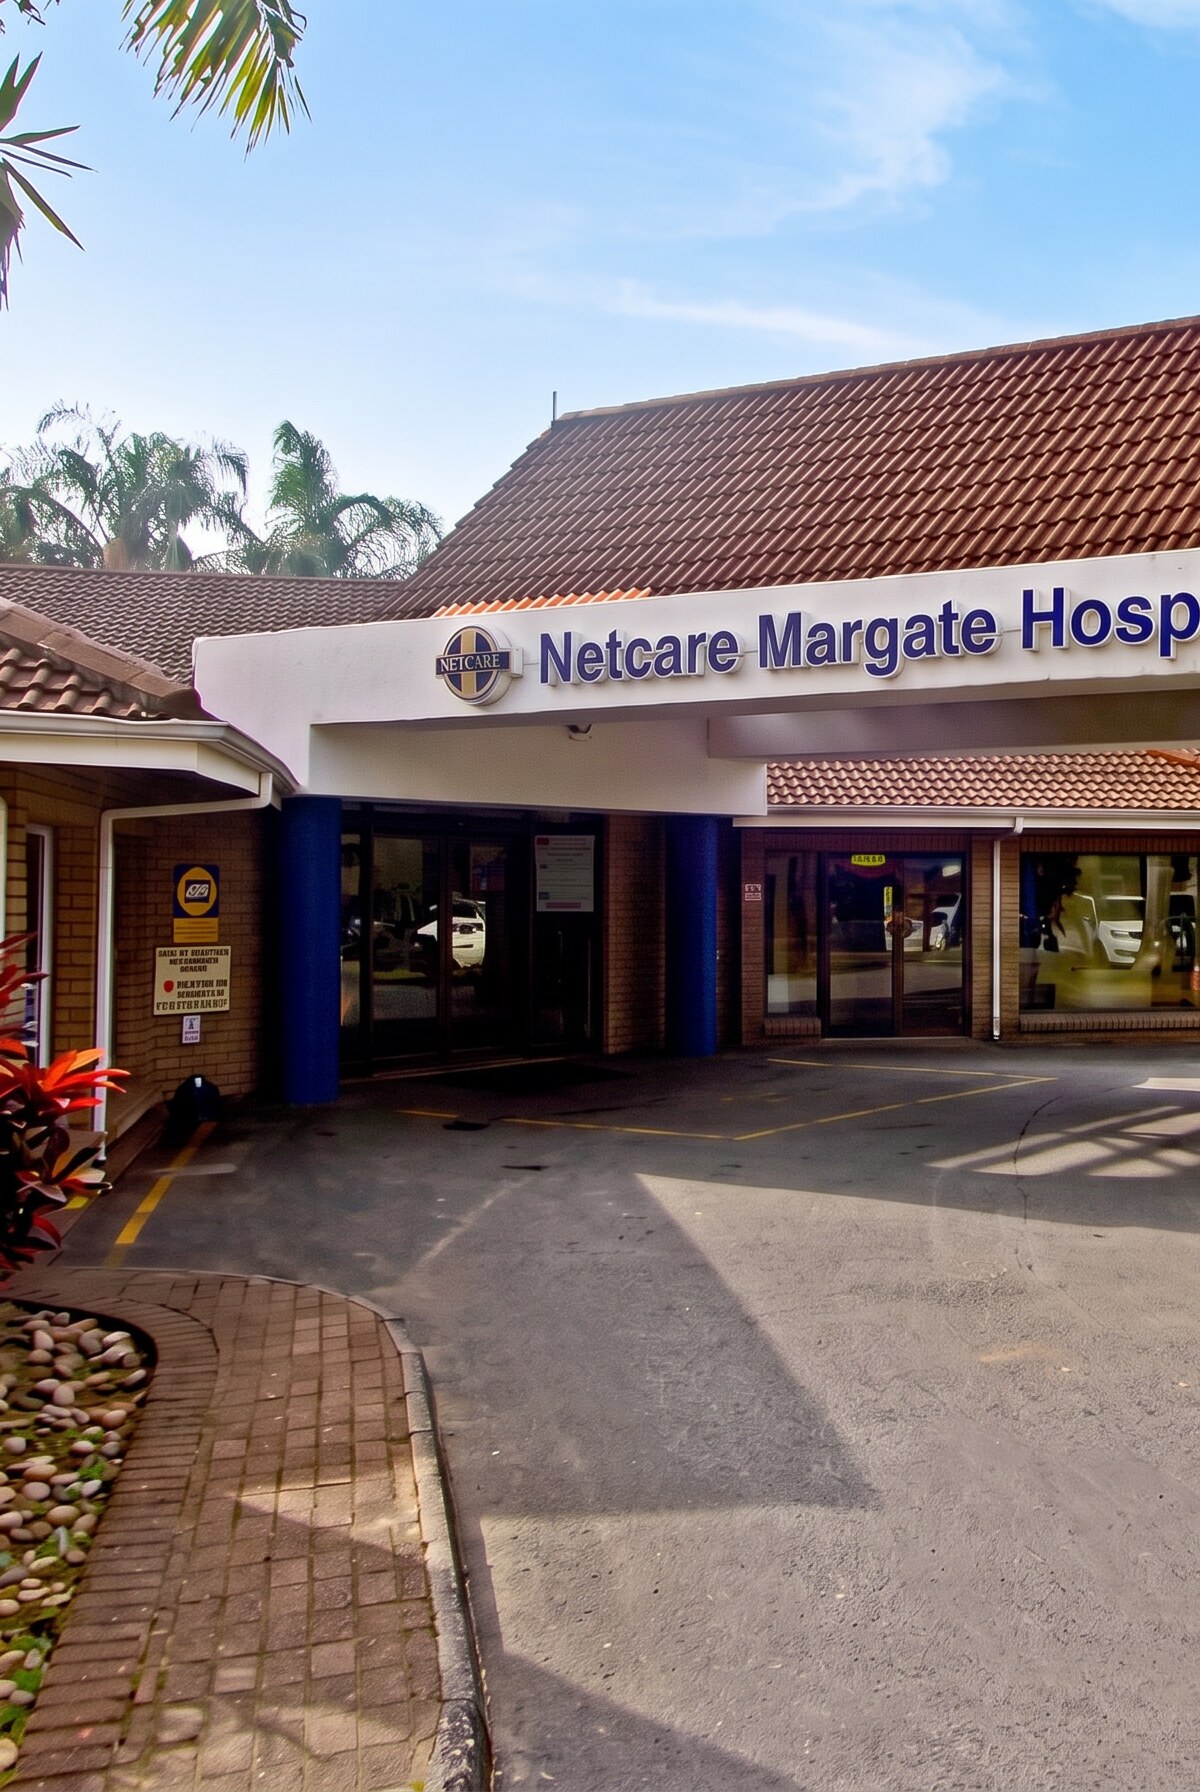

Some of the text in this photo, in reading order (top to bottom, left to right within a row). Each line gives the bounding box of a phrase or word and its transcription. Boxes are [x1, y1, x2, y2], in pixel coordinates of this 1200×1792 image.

[440, 654, 501, 672] NETCARE
[539, 629, 740, 685] Netcare
[757, 600, 998, 677] Margate
